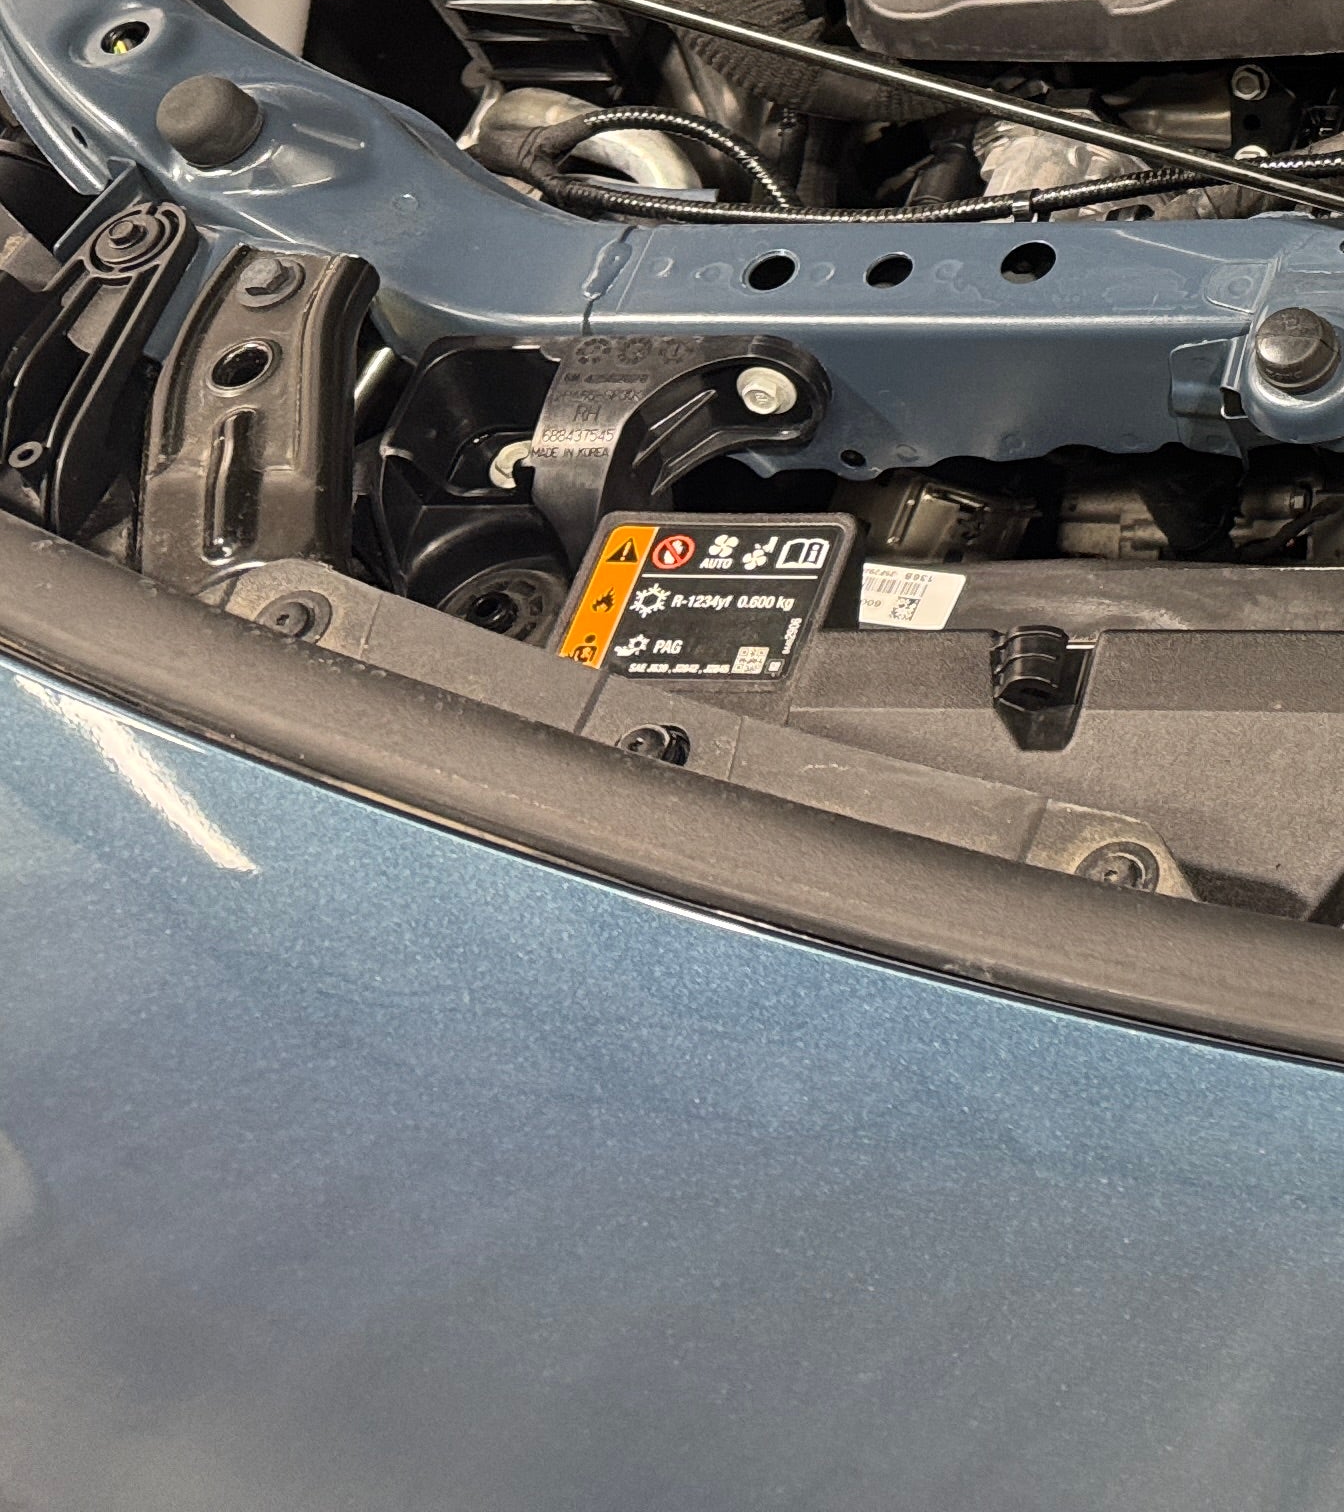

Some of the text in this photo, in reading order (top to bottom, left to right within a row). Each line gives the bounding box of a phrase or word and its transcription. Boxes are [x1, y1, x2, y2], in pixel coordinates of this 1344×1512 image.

[542, 428, 615, 442] 688437545
[532, 447, 610, 458] MADE IN KOREA
[700, 557, 733, 570] AUTO
[671, 595, 795, 612] R-1234yf 0.600 kg
[653, 639, 684, 655] PAG
